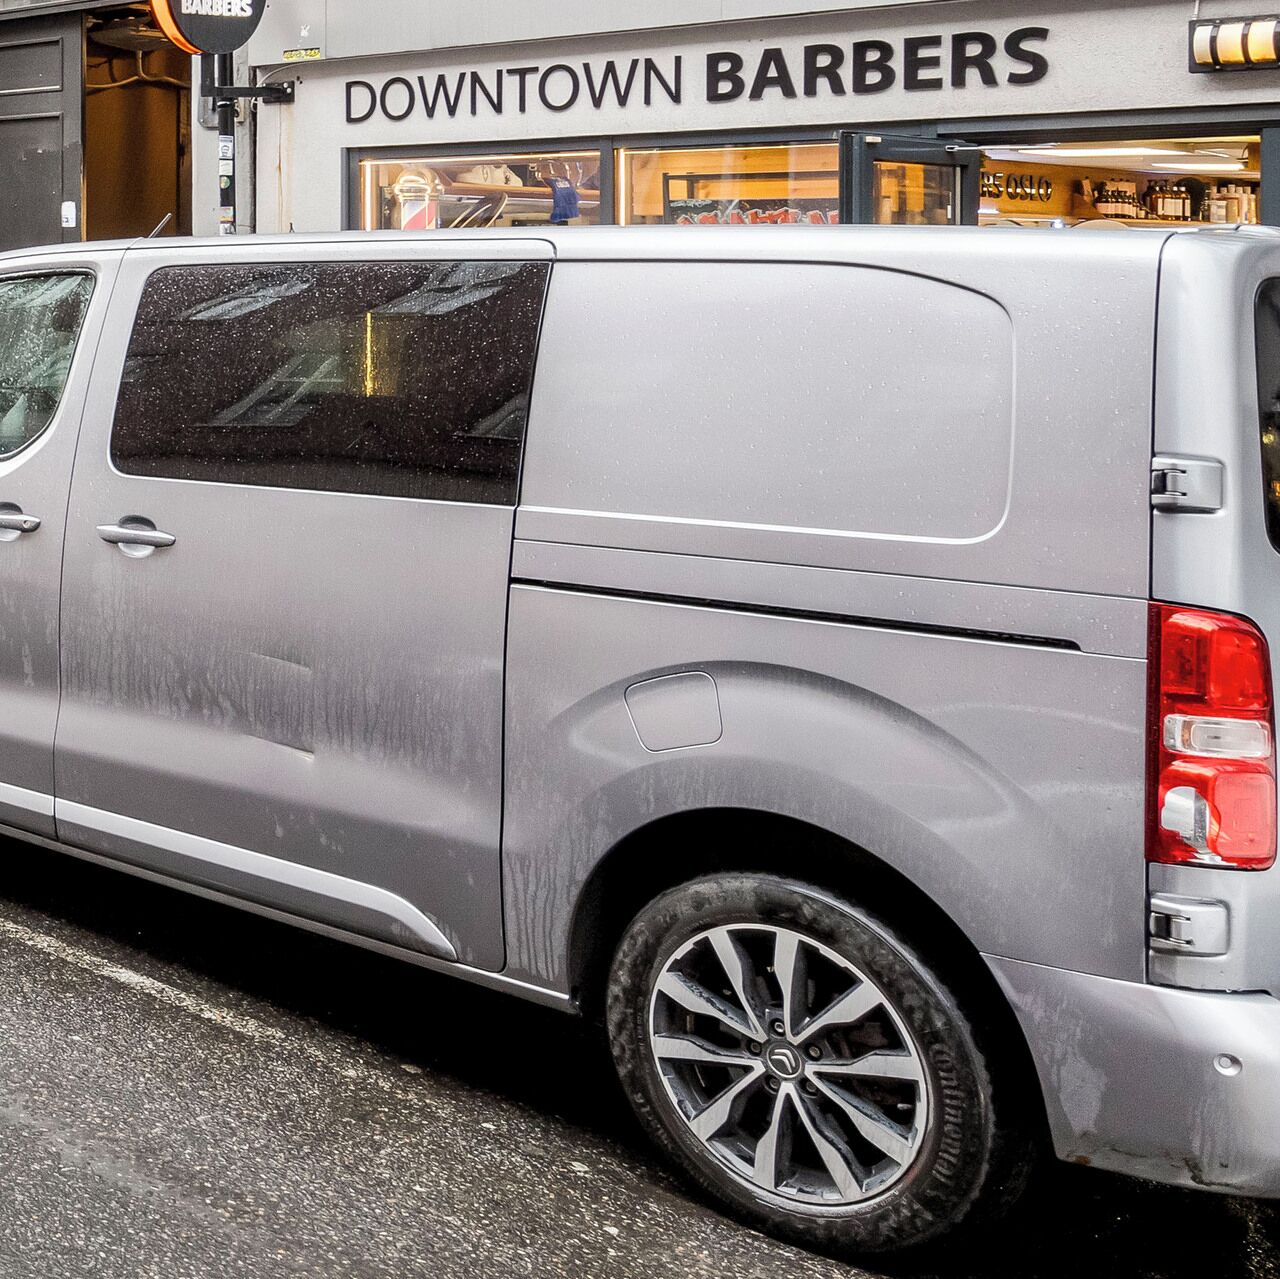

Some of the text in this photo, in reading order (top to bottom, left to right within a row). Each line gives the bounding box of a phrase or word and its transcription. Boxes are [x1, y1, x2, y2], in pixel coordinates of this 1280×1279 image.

[344, 26, 1050, 124] DOWNTOWN BARBERS
[1005, 173, 1052, 202] OSLO
